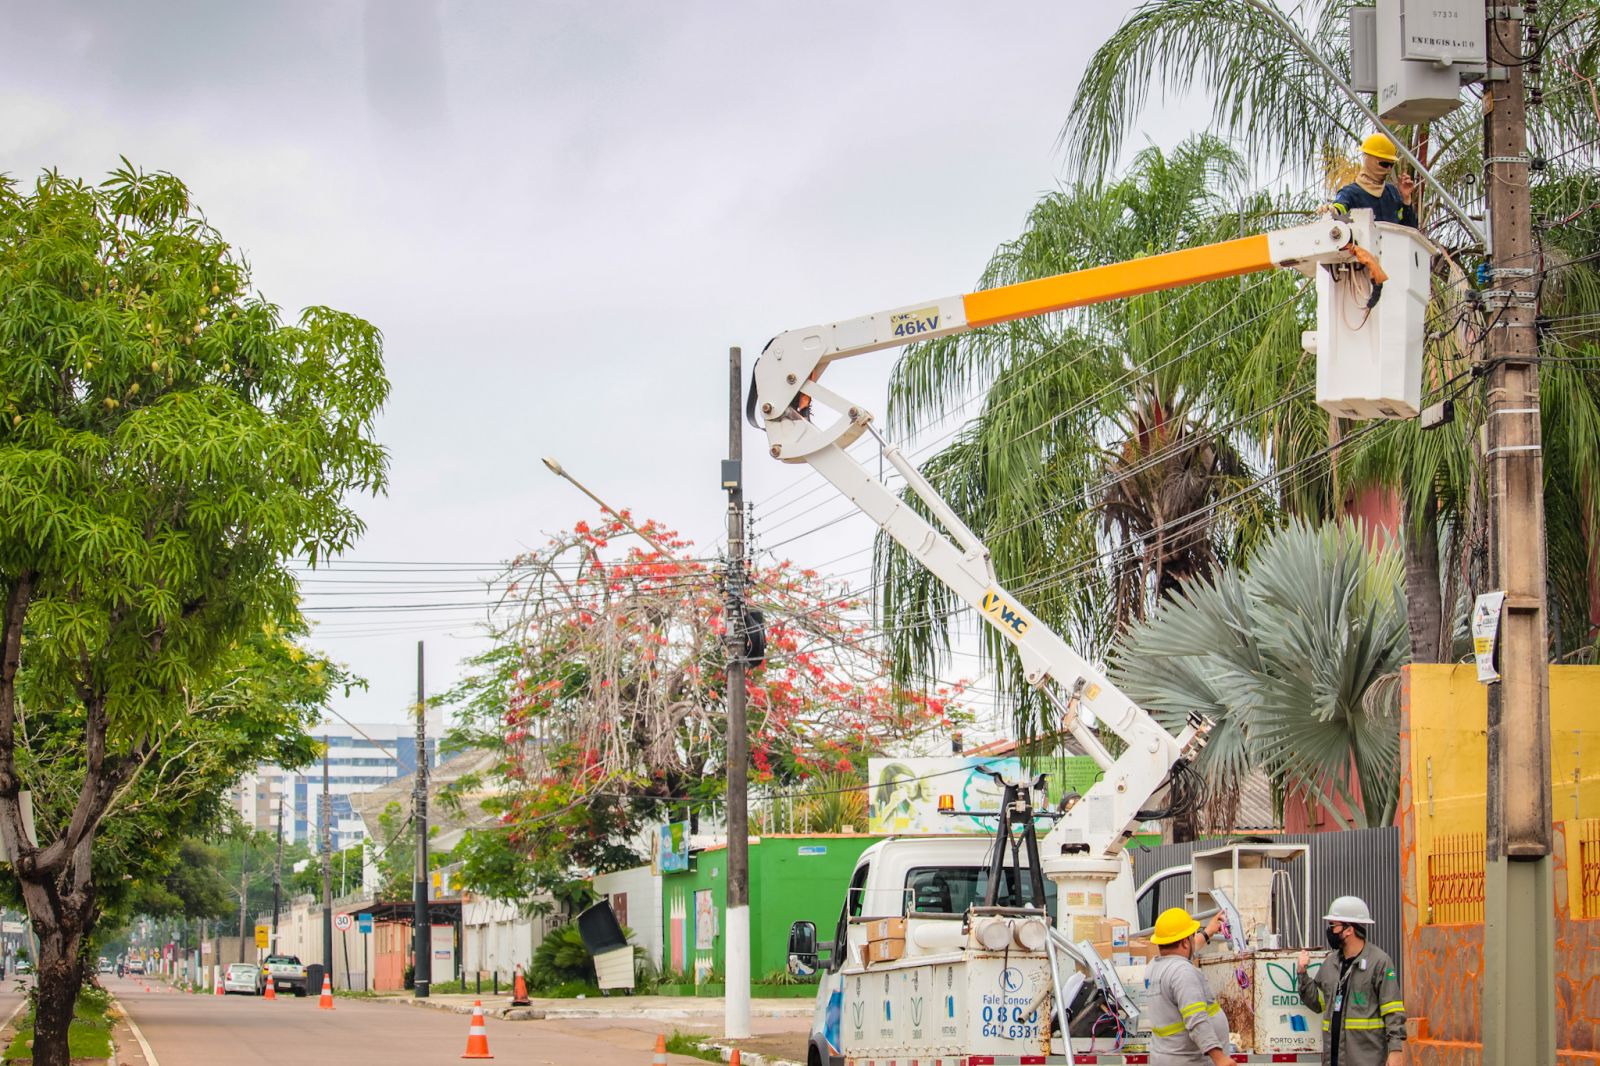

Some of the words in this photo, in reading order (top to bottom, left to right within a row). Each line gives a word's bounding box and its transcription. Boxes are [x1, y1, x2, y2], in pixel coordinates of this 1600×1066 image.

[895, 315, 938, 336] 46kV
[337, 916, 348, 925] 30
[983, 994, 1000, 1005] Fale
